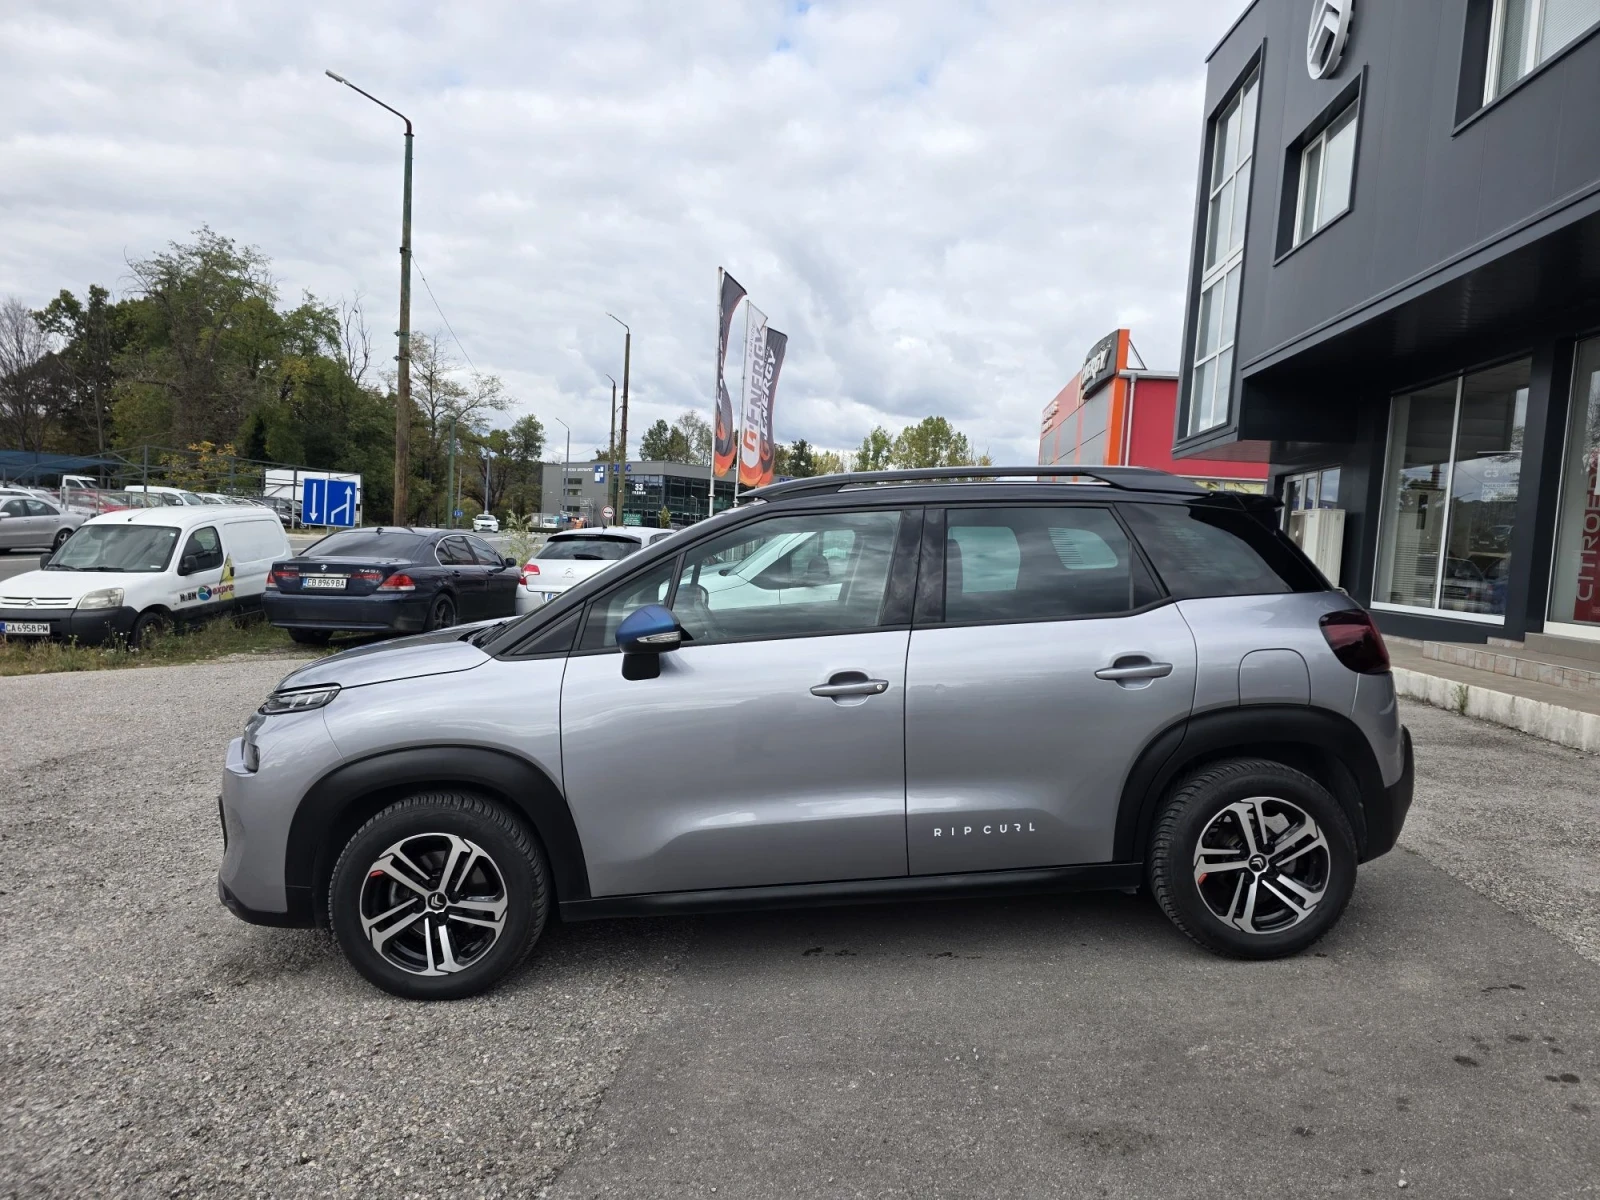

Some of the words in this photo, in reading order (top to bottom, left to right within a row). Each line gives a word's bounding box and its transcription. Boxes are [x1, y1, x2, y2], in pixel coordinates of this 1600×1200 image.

[634, 483, 644, 491] 33
[934, 827, 972, 837] RIP
[983, 822, 1035, 834] CURL
